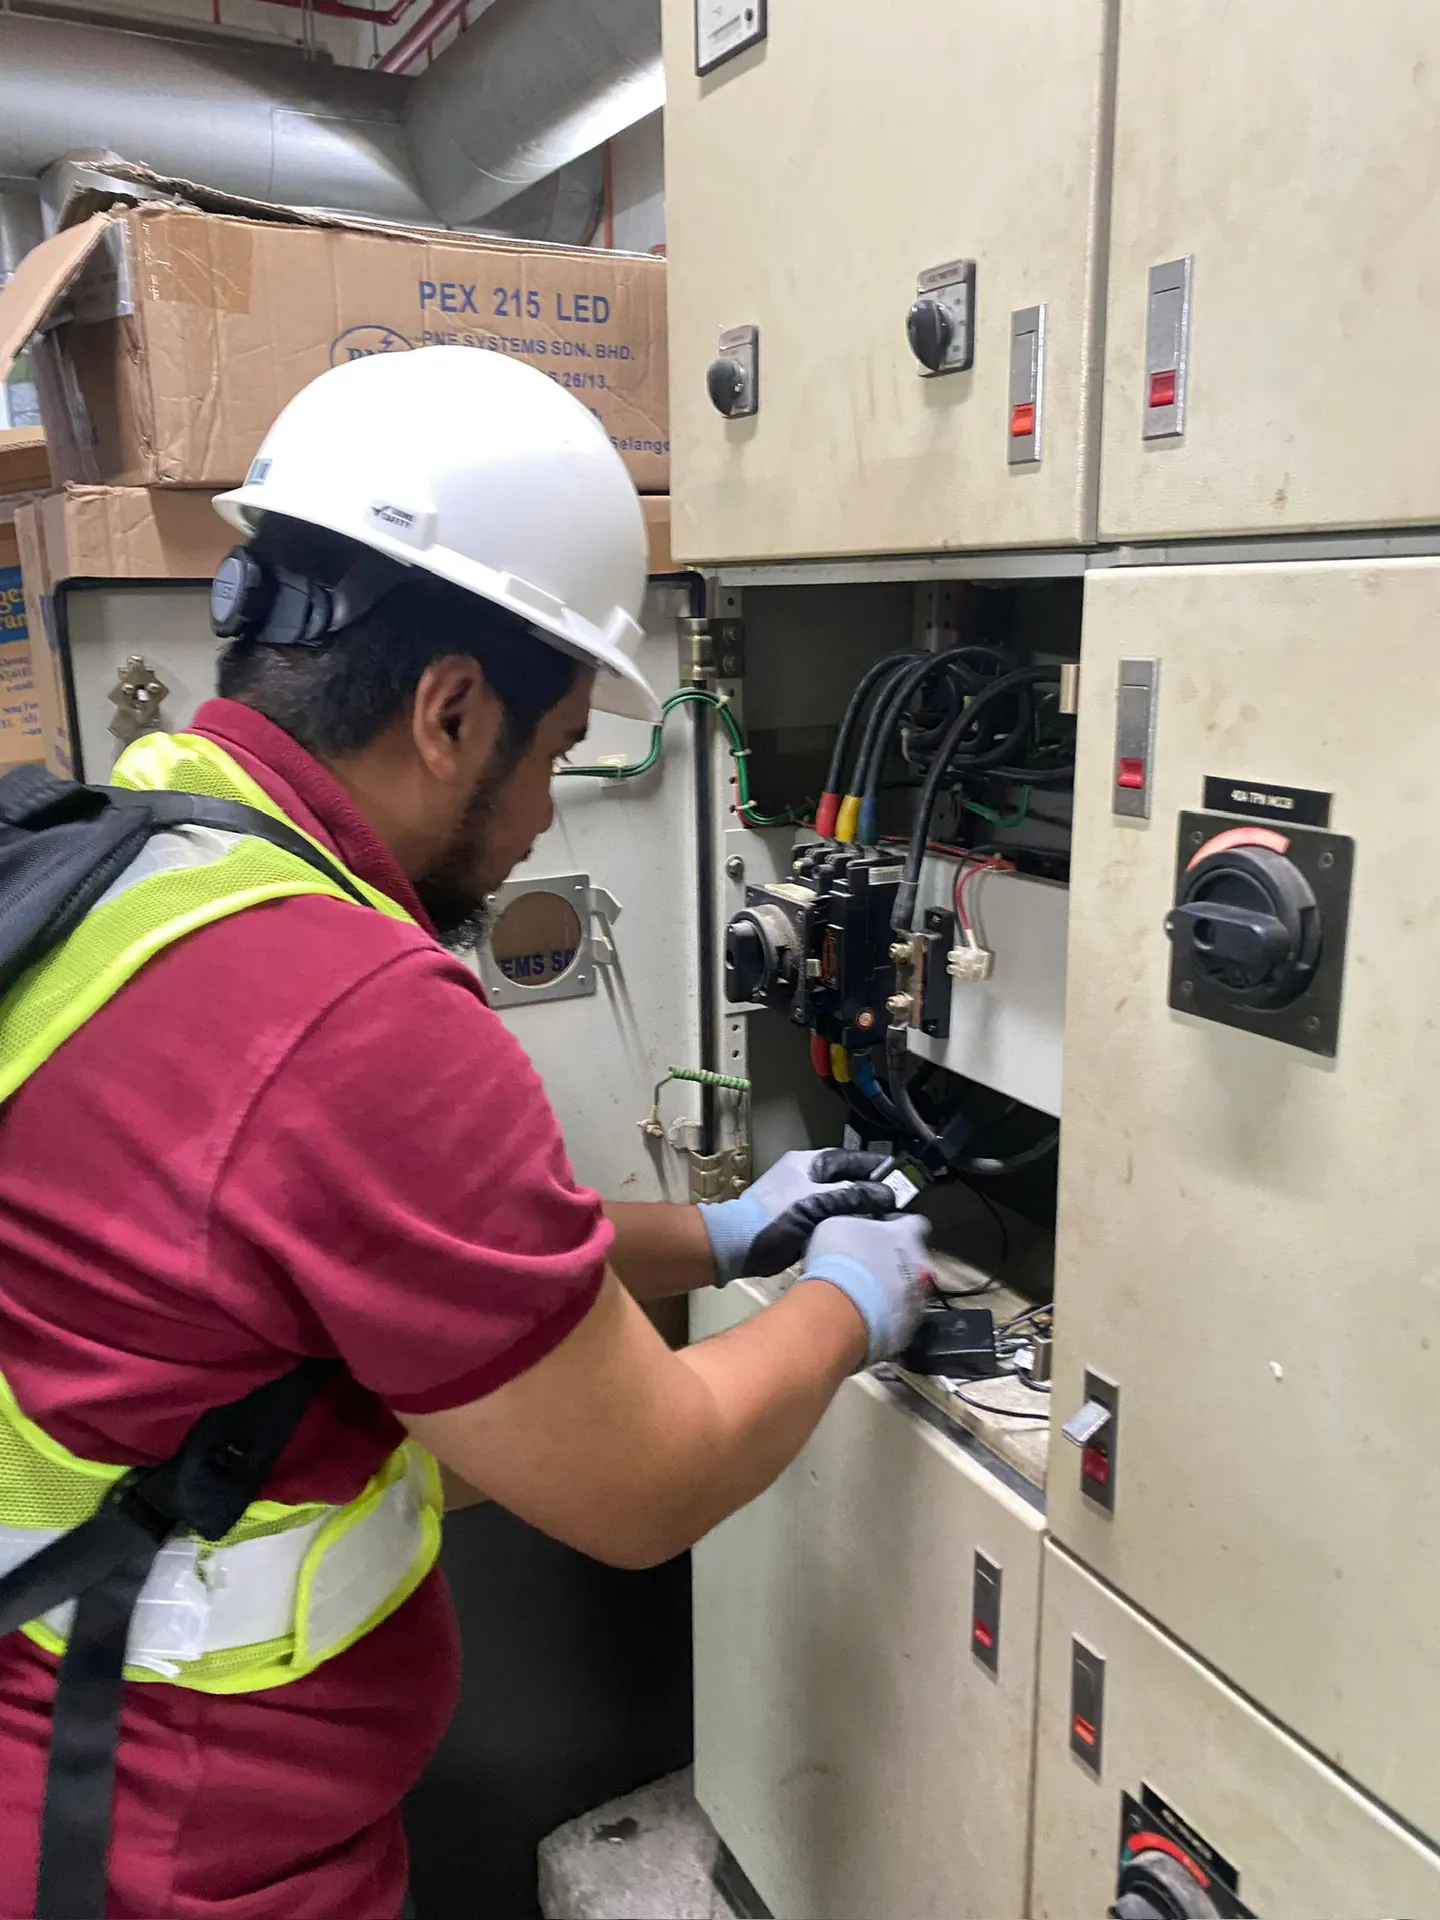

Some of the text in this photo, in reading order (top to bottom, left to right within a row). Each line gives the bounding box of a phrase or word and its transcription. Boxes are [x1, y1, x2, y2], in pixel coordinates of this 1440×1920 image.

[419, 281, 610, 324] PEX 215 LED
[464, 335, 546, 355] SYSTEMS
[551, 341, 591, 358] SDN.
[596, 344, 635, 361] BHD.
